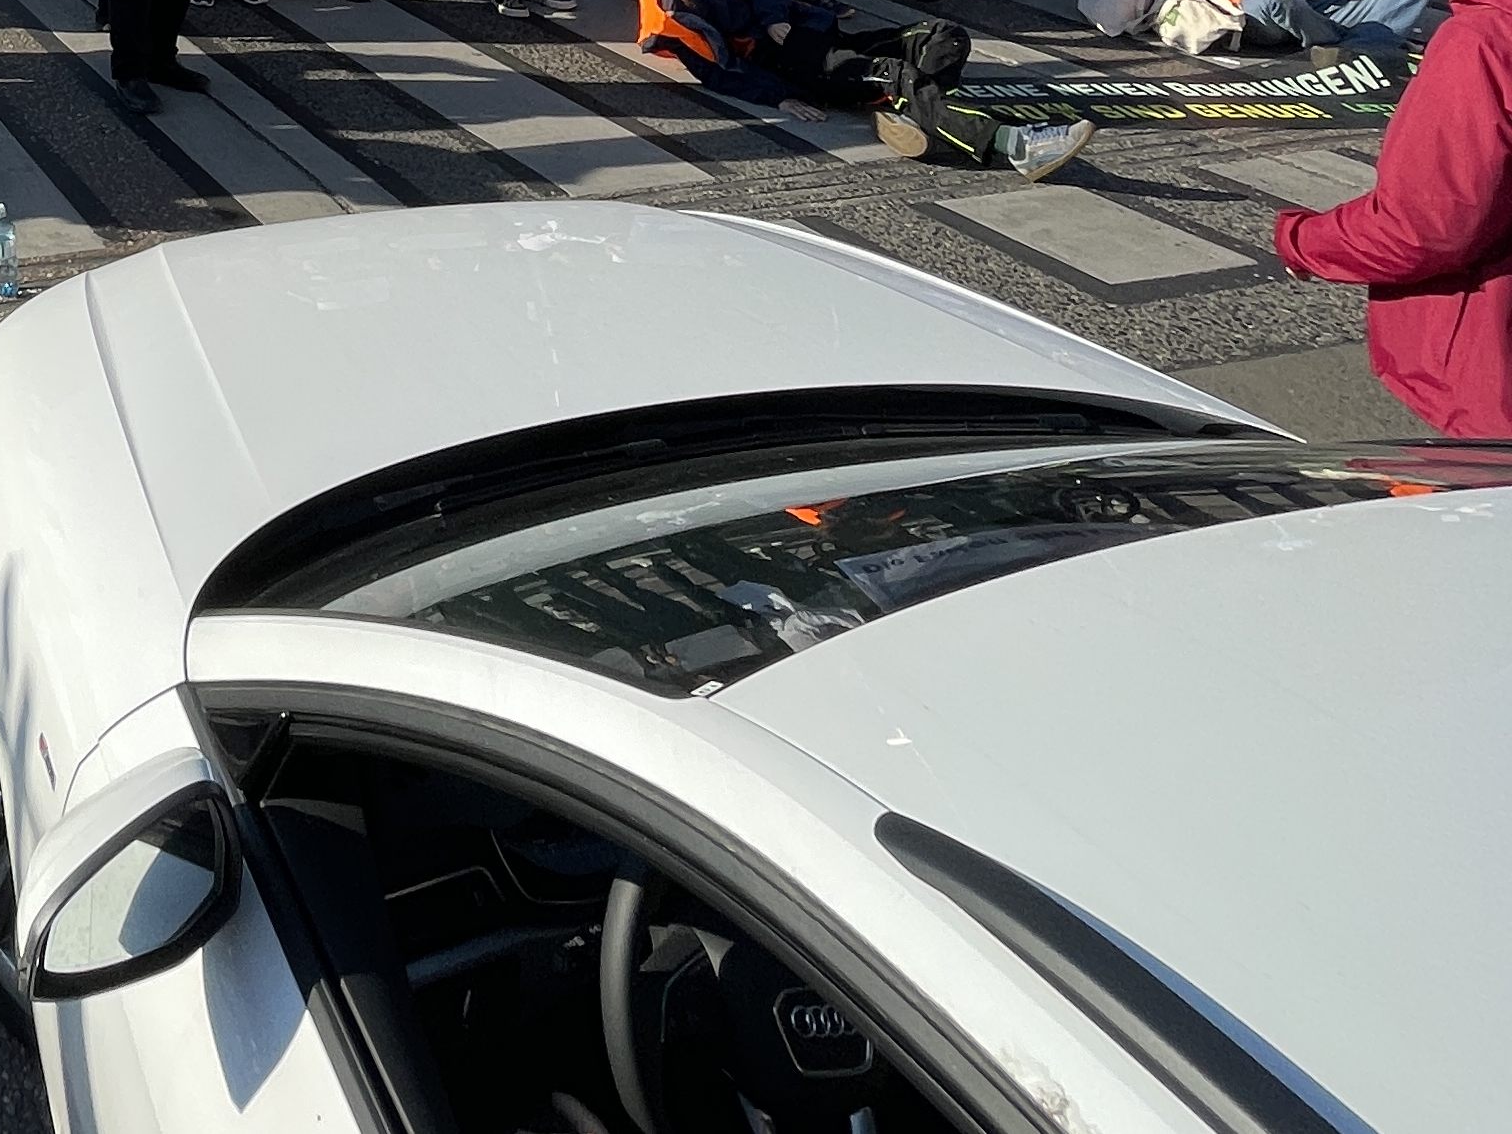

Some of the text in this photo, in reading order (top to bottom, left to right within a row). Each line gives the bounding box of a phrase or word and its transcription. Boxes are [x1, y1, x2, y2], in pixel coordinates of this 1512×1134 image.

[1047, 82, 1170, 97] NEUEN
[1162, 54, 1391, 98] BOHRUNGEN!
[1090, 103, 1187, 119] SIND
[1185, 102, 1333, 119] GENUG!
